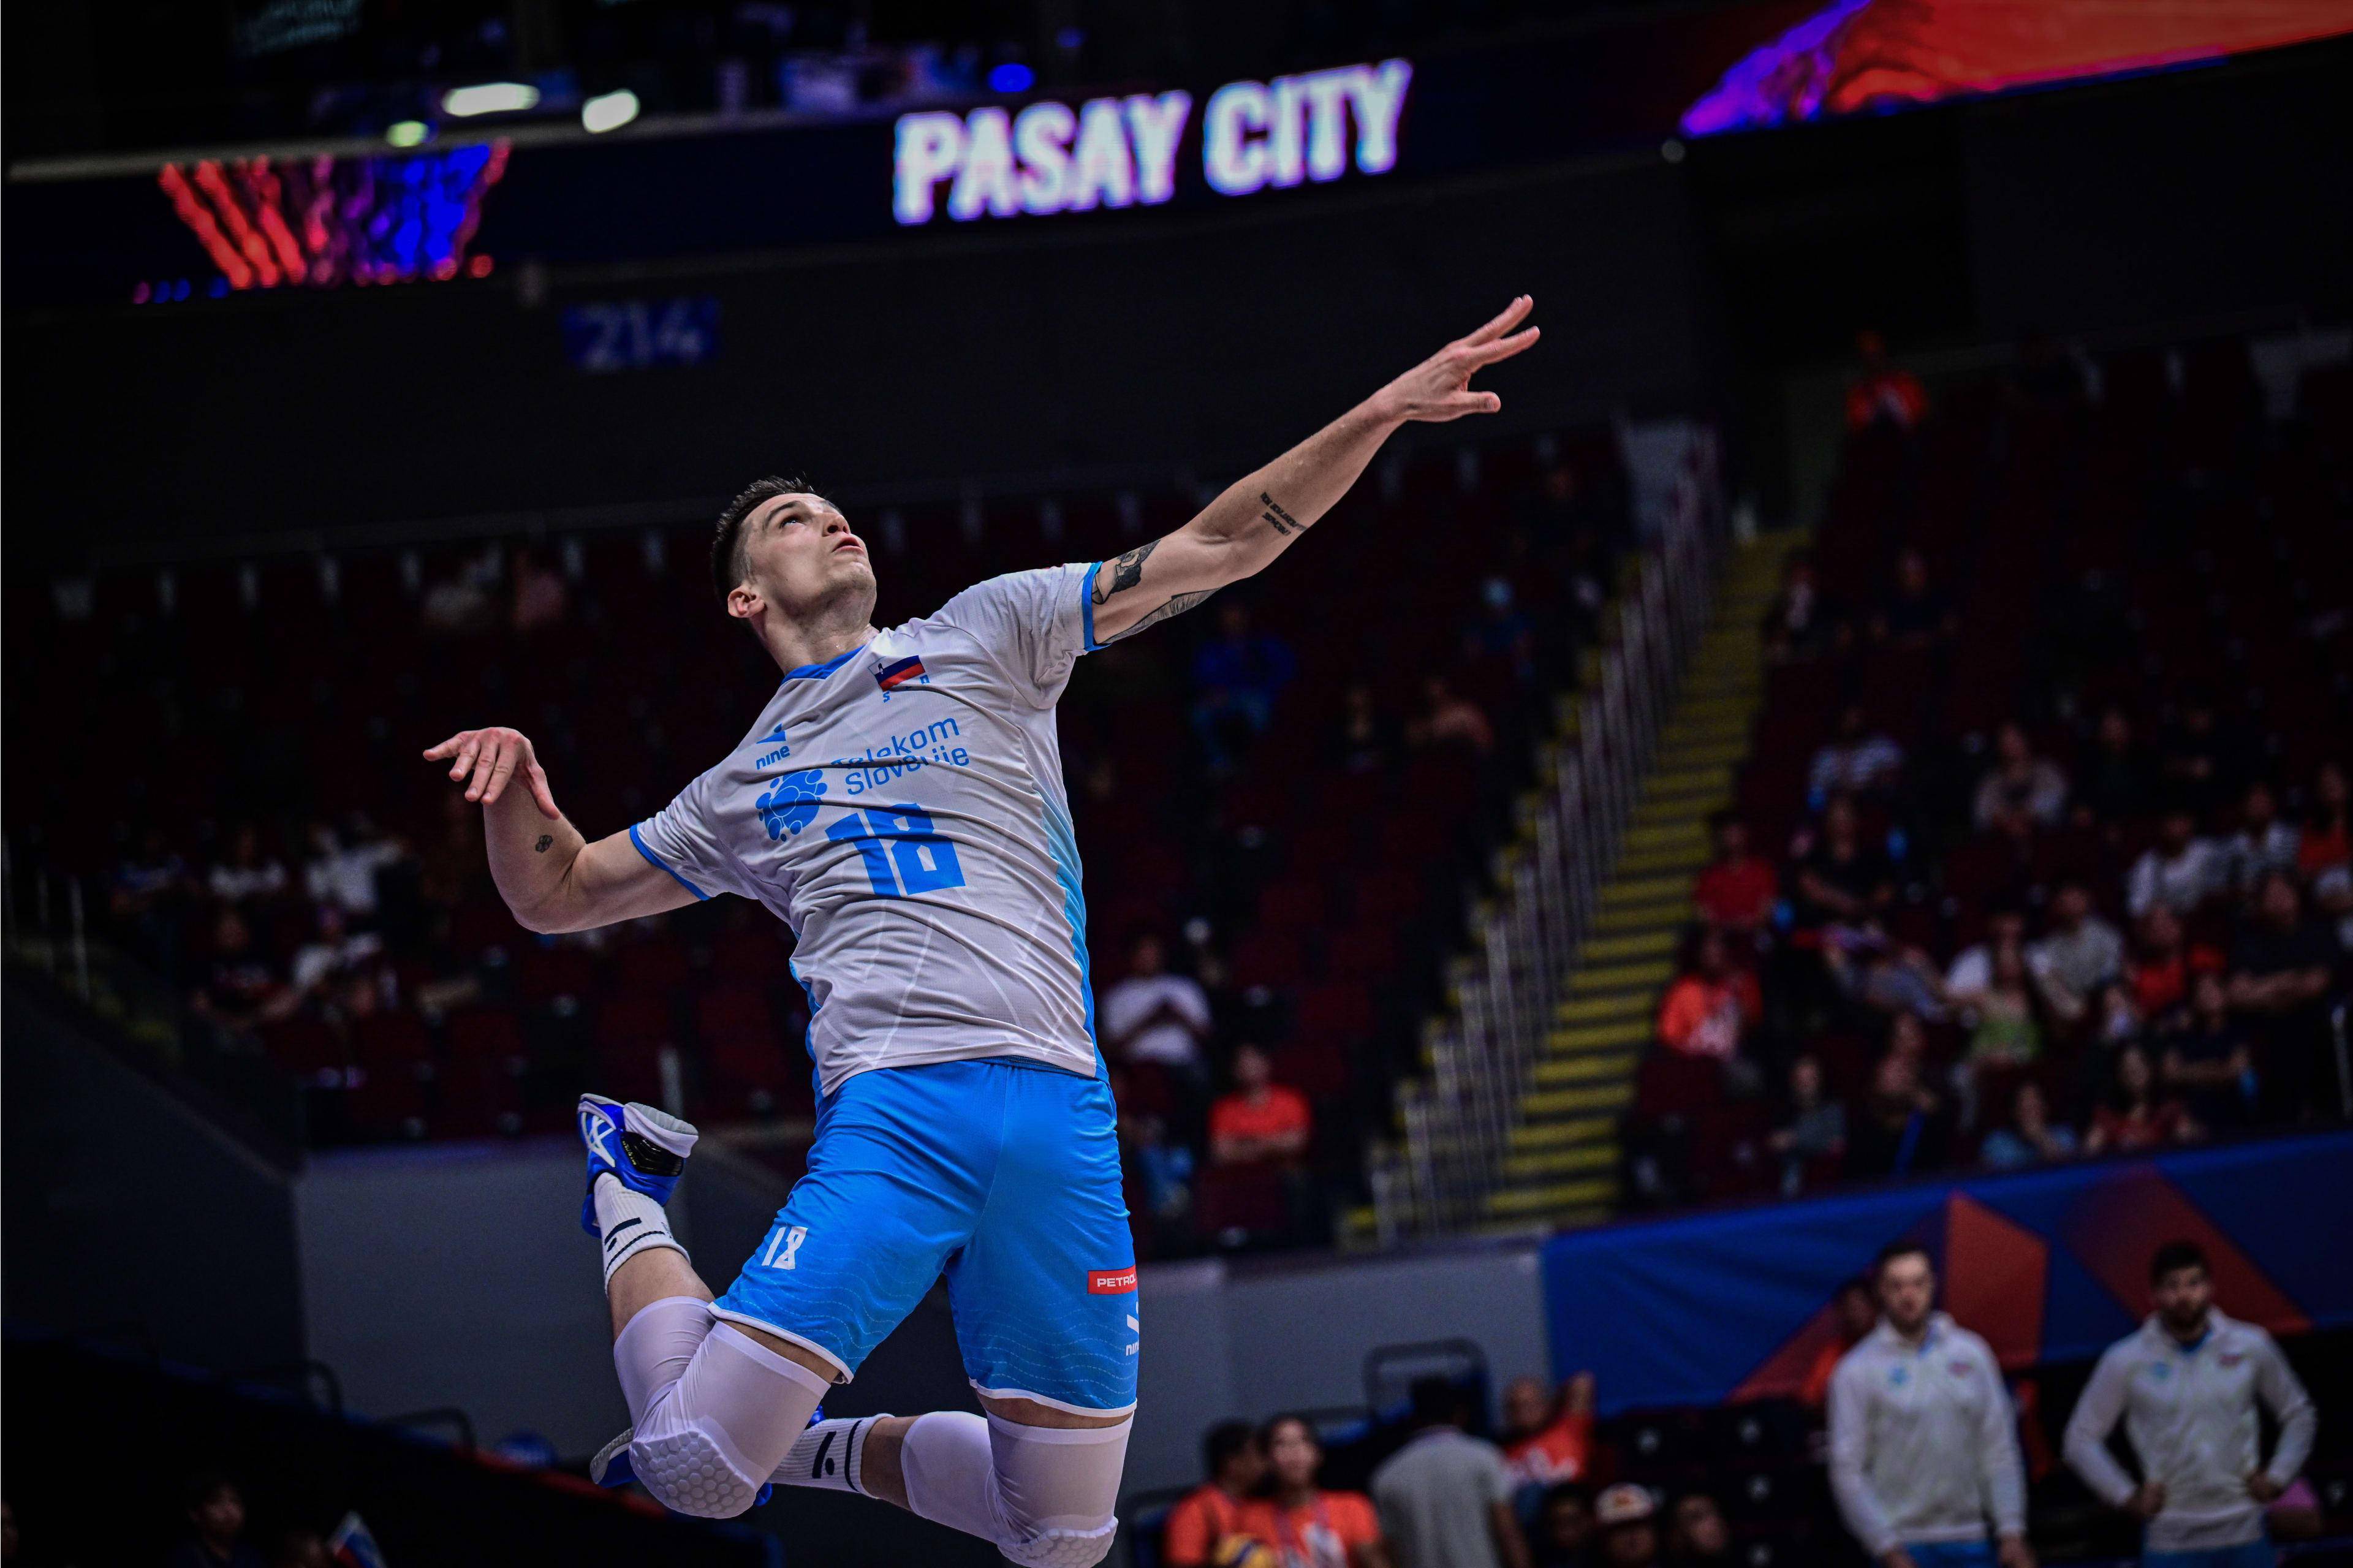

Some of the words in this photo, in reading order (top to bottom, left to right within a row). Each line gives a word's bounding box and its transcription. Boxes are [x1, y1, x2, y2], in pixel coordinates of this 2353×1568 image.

[892, 89, 1194, 227] PASAY
[1202, 57, 1415, 197] CITY
[578, 299, 703, 371] 214
[756, 746, 790, 770] nine
[825, 803, 966, 898] 18
[761, 1226, 809, 1270] 18
[1126, 1340, 1139, 1357] nin
